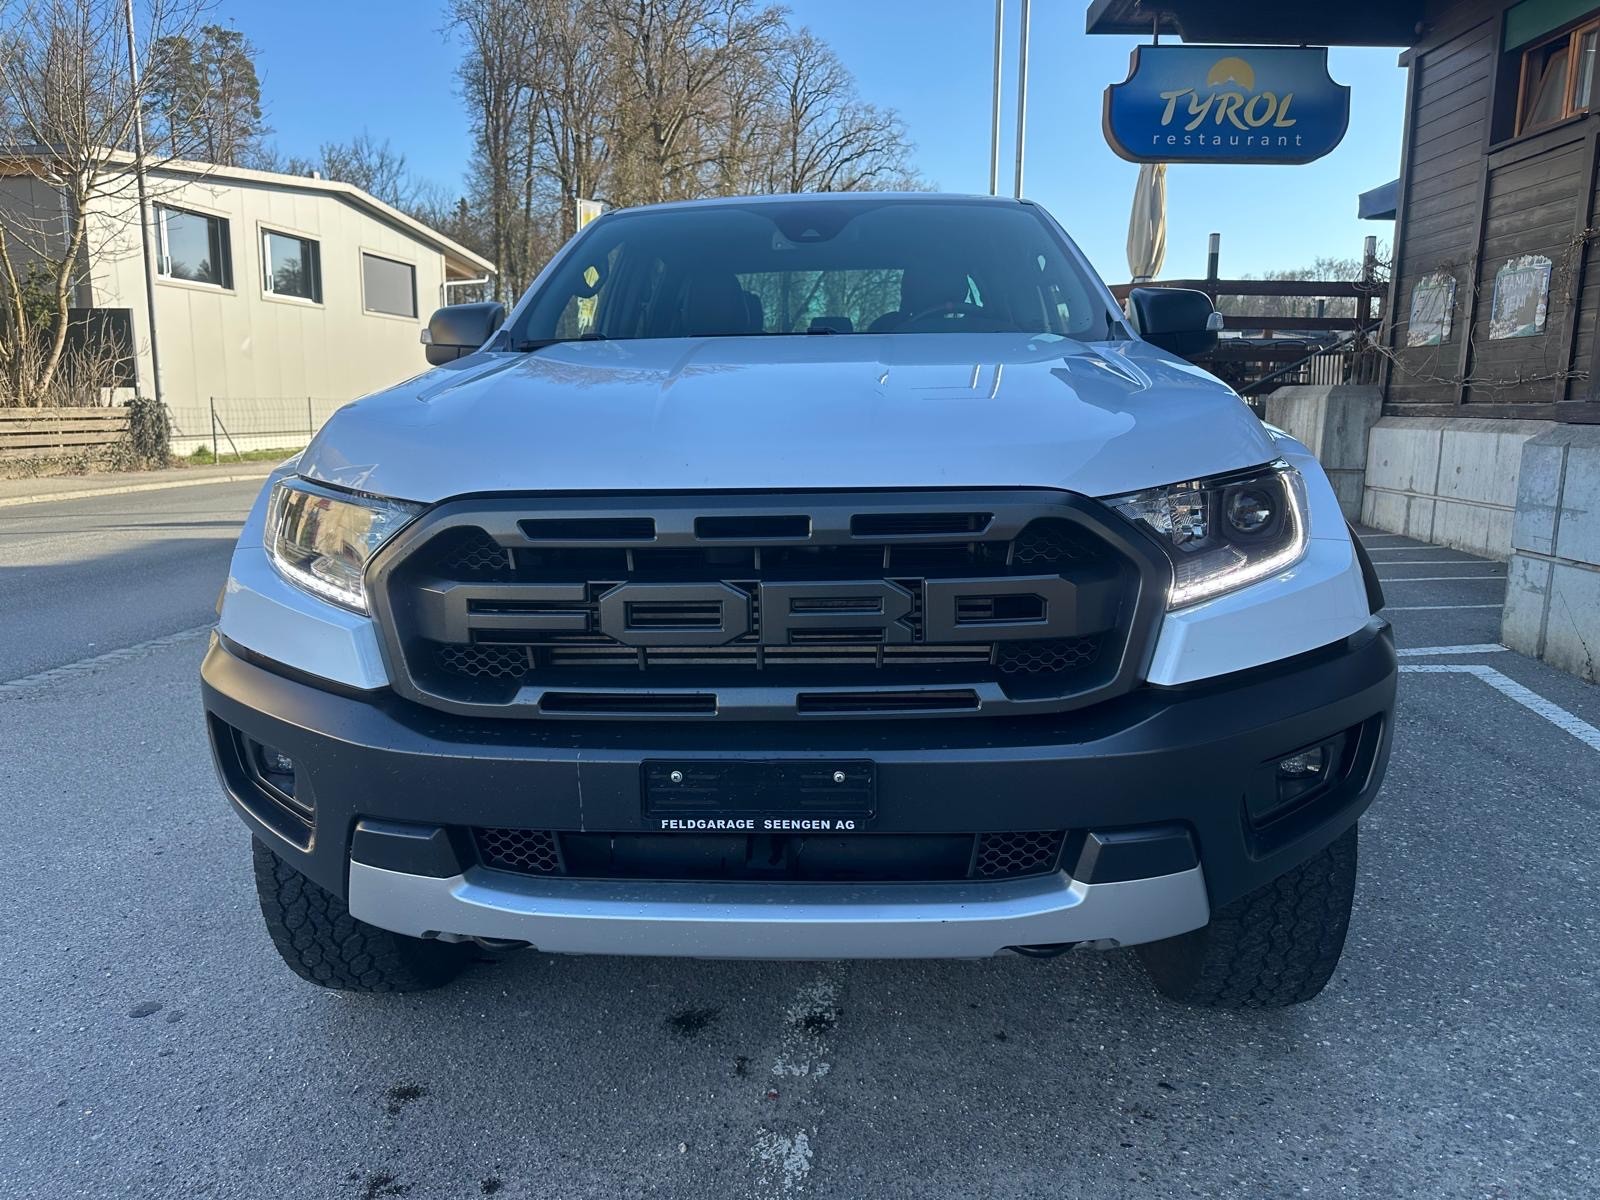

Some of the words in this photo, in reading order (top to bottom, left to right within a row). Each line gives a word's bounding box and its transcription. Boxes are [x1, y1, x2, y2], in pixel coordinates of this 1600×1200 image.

[1160, 88, 1297, 131] TYROL
[1153, 133, 1302, 146] restaurant
[444, 575, 1078, 645] FORD
[661, 819, 755, 830] FELDGARAGE
[764, 819, 831, 830] SEENGEN
[835, 819, 856, 830] AG
